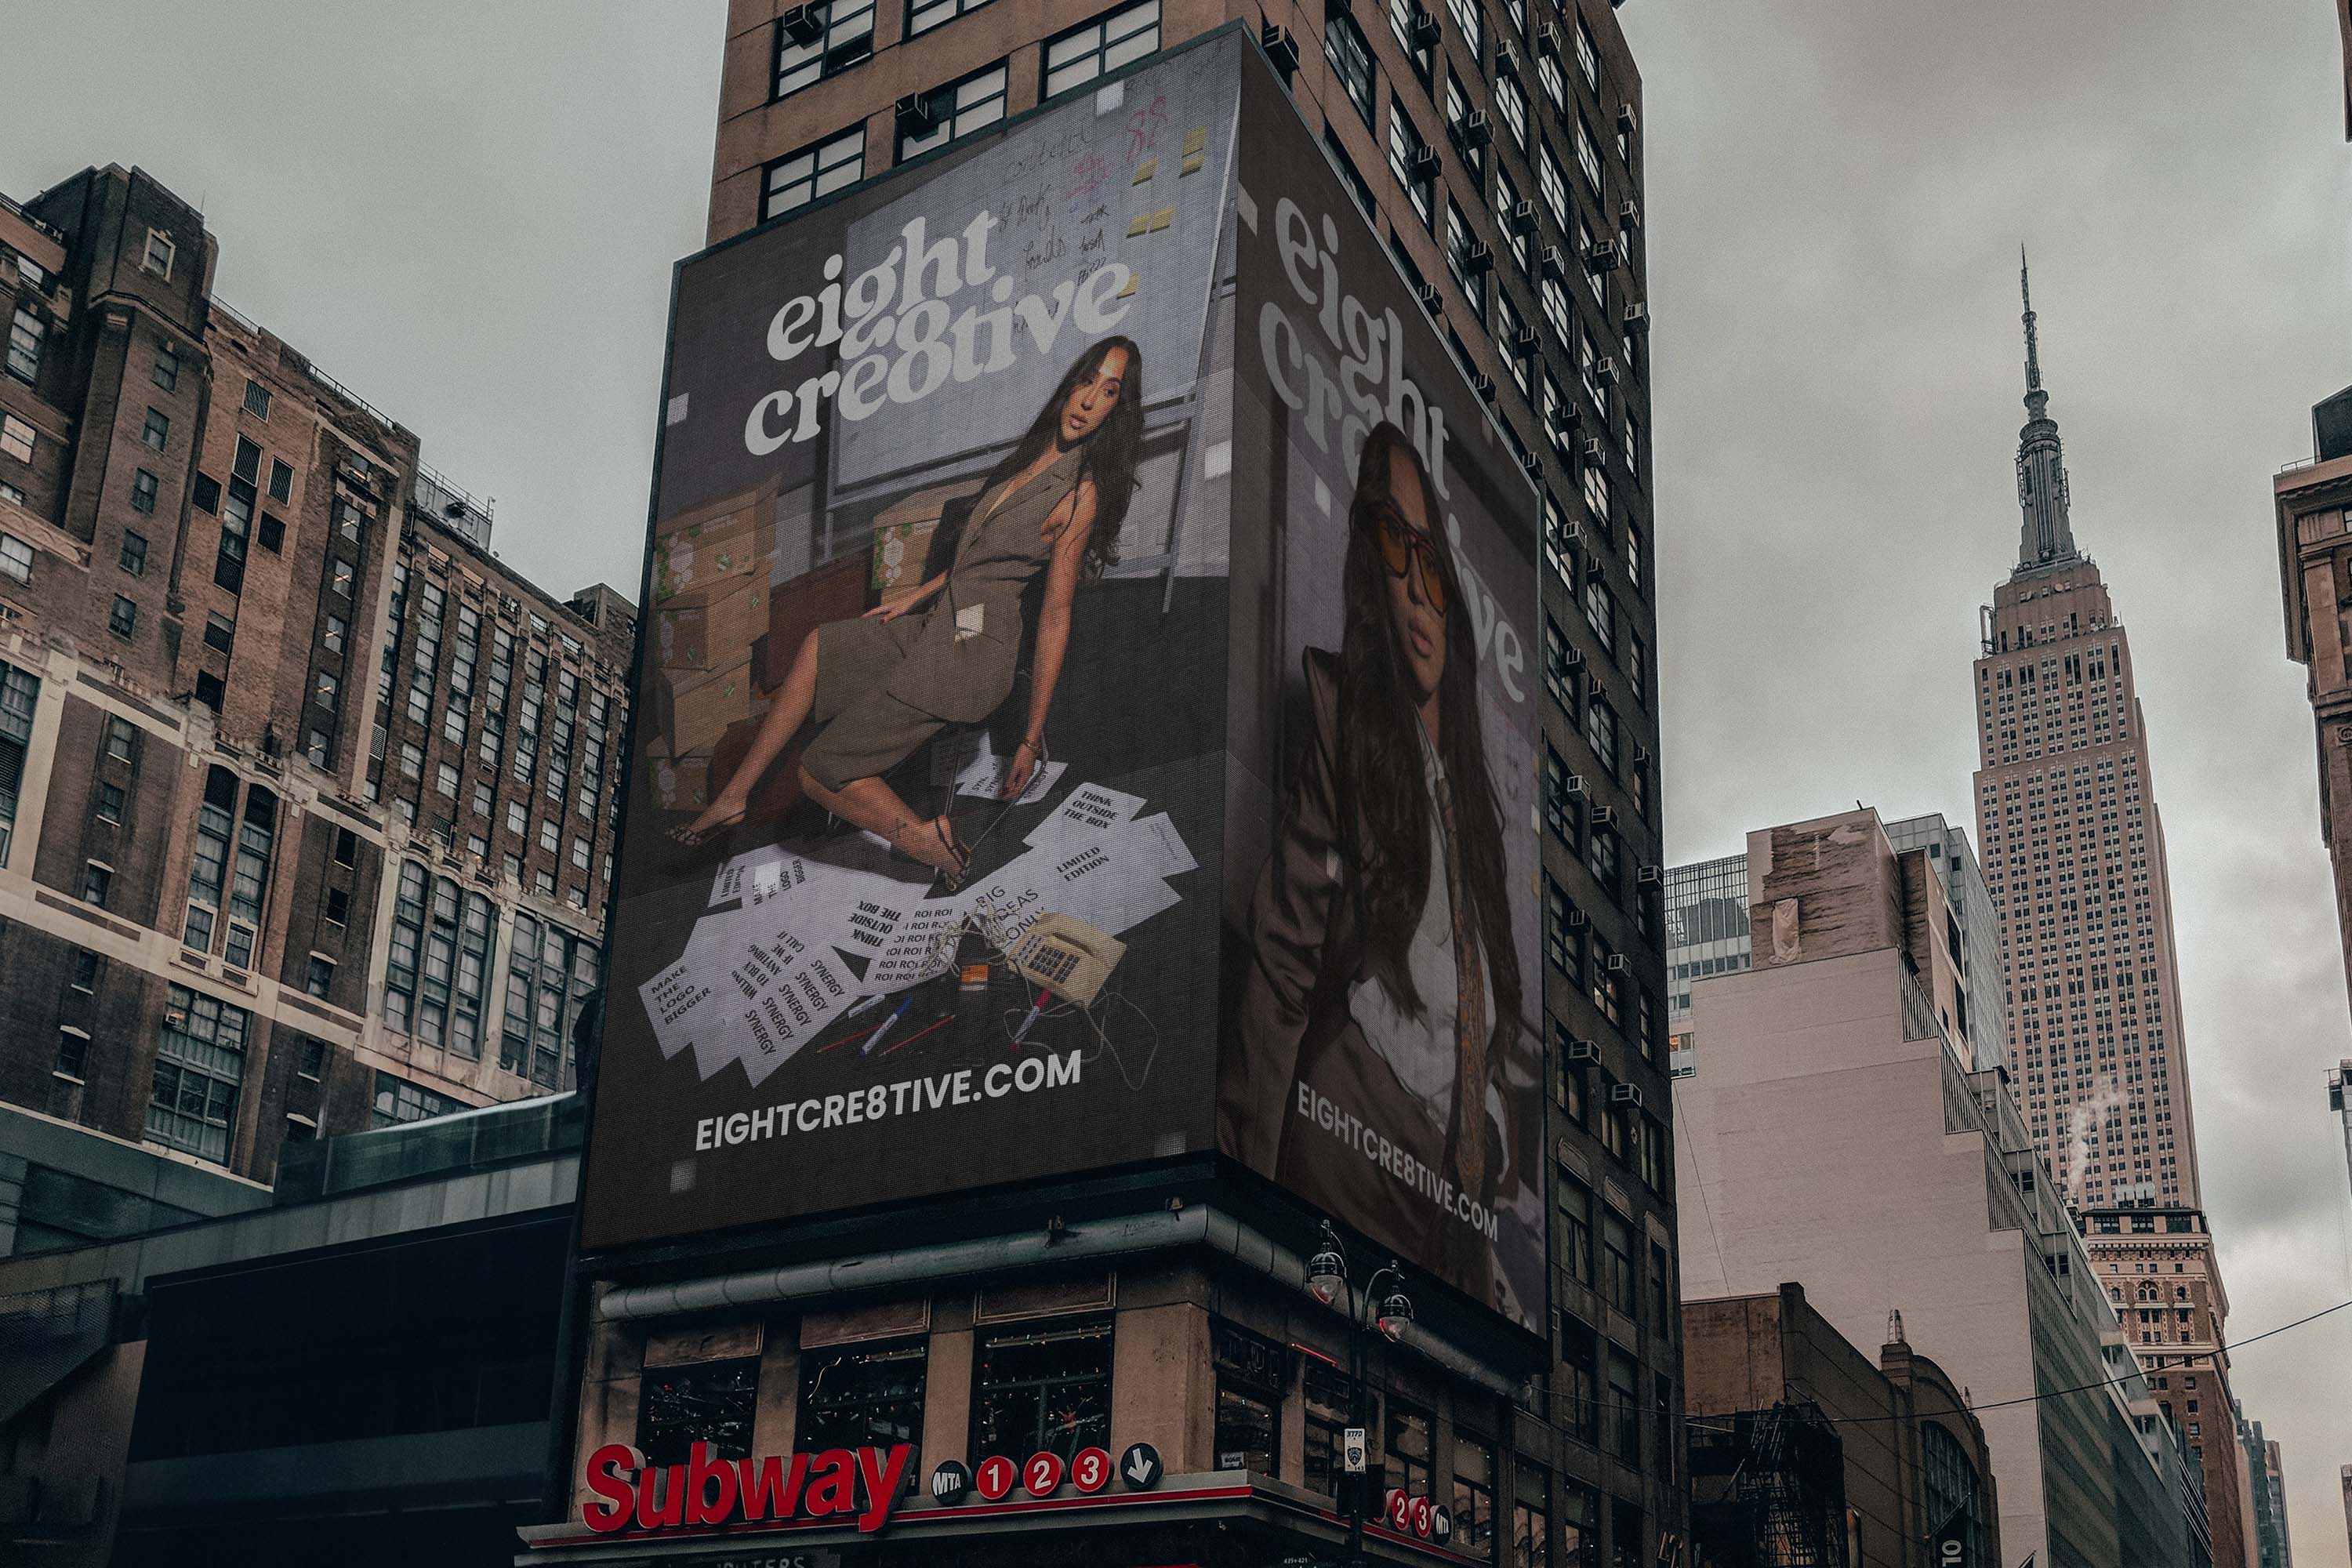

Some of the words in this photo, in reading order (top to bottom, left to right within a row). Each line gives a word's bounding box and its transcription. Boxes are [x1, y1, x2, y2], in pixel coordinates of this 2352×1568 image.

[767, 209, 999, 361] eight
[744, 263, 1131, 456] cre8tive
[1275, 197, 1450, 501] eight
[1073, 800, 1119, 820] OUTSIDE
[1081, 791, 1112, 807] THINK
[1064, 809, 1085, 821] THE
[1086, 816, 1111, 829] BOX
[1056, 847, 1101, 873] LIMITED
[1064, 855, 1109, 882] EDITION
[780, 871, 792, 891] LOGO
[857, 901, 879, 916] BOX
[976, 886, 1005, 907] BIG
[996, 889, 1038, 920] DEAS
[848, 913, 893, 935] OUTSIDE
[880, 908, 902, 921] THE
[914, 909, 931, 918] ROI
[935, 909, 953, 917] ROI
[777, 931, 786, 940] IT
[852, 928, 884, 948] THINK
[909, 922, 928, 931] ROI
[771, 943, 786, 957] WE
[786, 937, 805, 953] CALL
[743, 961, 759, 978] BUY
[747, 944, 782, 975] ANYTHING
[782, 954, 794, 966] IF
[879, 960, 897, 969] ROI
[898, 960, 918, 969] ROI
[651, 965, 688, 993] MAKE
[755, 973, 770, 987] TO
[811, 960, 845, 996] SYNERGY
[875, 973, 892, 982] ROI
[895, 973, 915, 982] ROI
[655, 983, 681, 1003] THE
[660, 985, 695, 1014] LOGO
[795, 971, 829, 1012] SYNERGY
[665, 987, 711, 1025] BIGGER
[779, 984, 811, 1027] SYNERGY
[762, 997, 794, 1040] SYNERGY
[745, 1010, 776, 1055] SYNERGY
[695, 1049, 1082, 1151] EIGHTCRE8TIVE.COM
[1298, 1080, 1497, 1243] EIGHTCRE8TIVE.COM
[583, 1441, 912, 1533] Subway
[932, 1472, 961, 1496] MTA
[987, 1464, 999, 1492] 1
[1033, 1460, 1051, 1490] 2
[1080, 1455, 1100, 1484] 3
[1396, 1497, 1405, 1523] 2
[1418, 1505, 1427, 1530] 3
[1436, 1513, 1449, 1534] MTA
